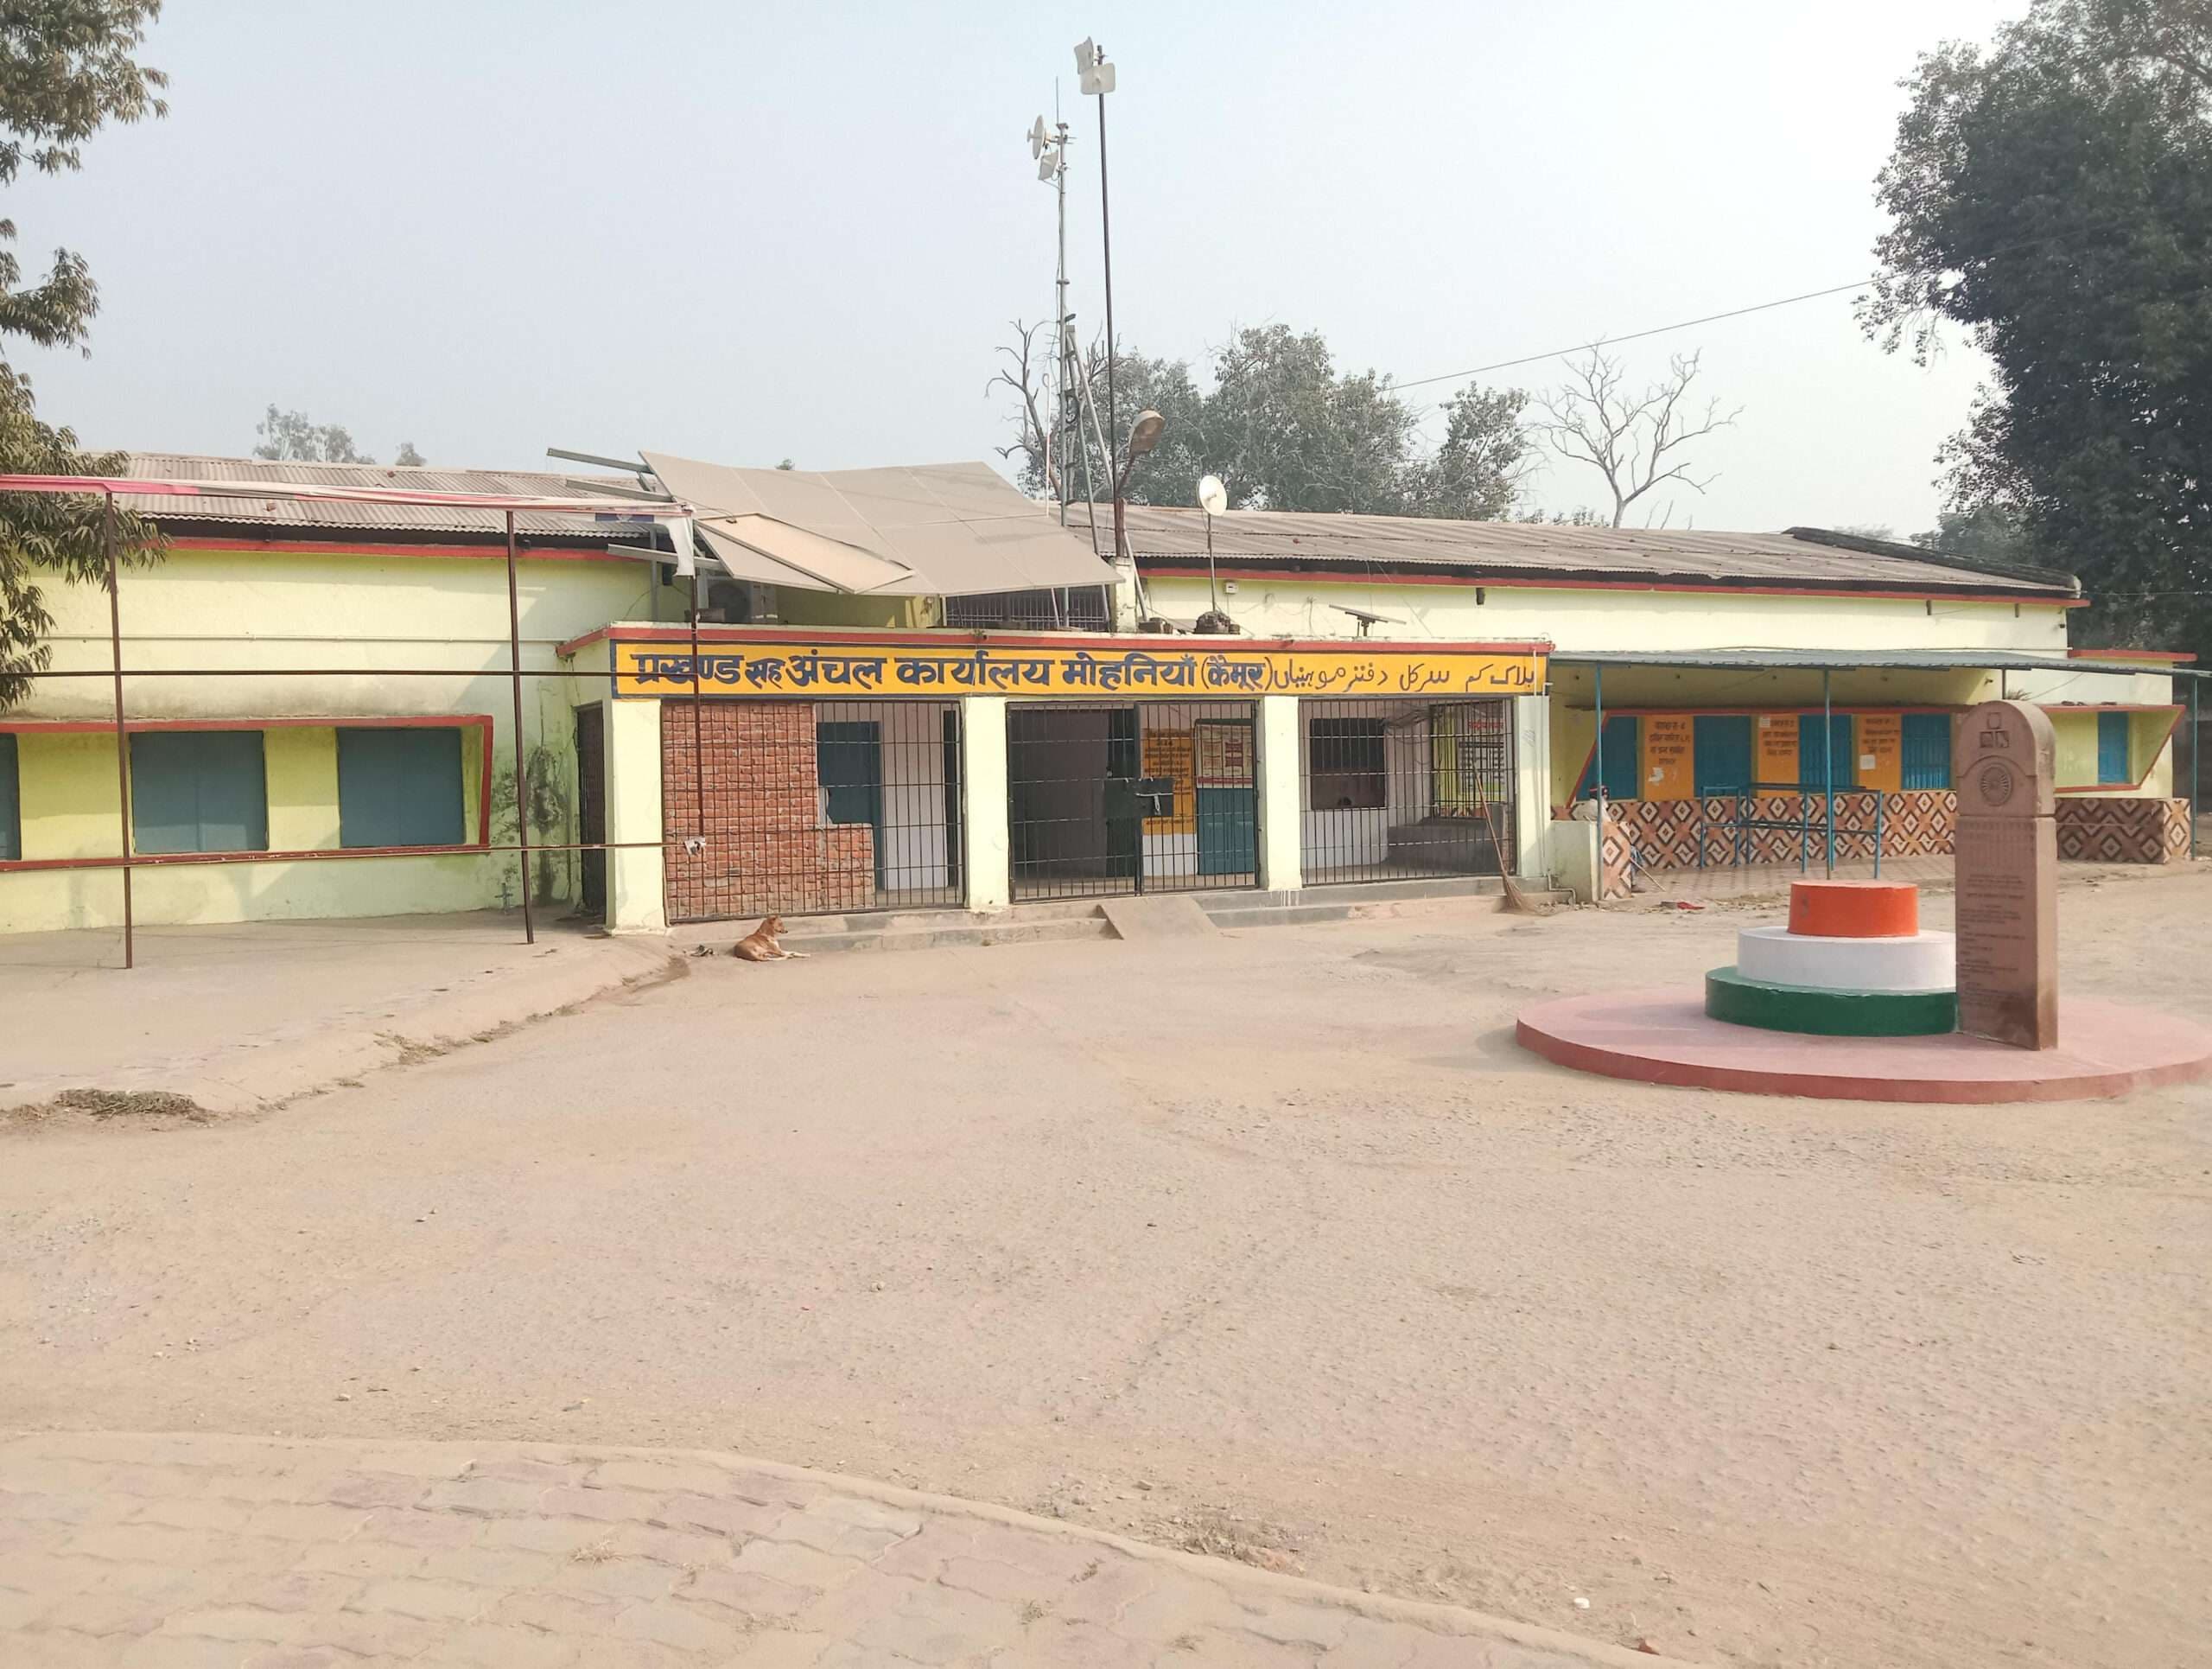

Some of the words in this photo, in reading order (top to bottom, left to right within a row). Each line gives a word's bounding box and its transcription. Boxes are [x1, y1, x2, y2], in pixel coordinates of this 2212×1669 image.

[630, 653, 745, 685] प्रखण्ड
[745, 657, 785, 690] सह
[785, 649, 887, 690] अंचल
[894, 649, 1055, 690] कार्यालय
[1060, 652, 1198, 691] मोहनियाँ
